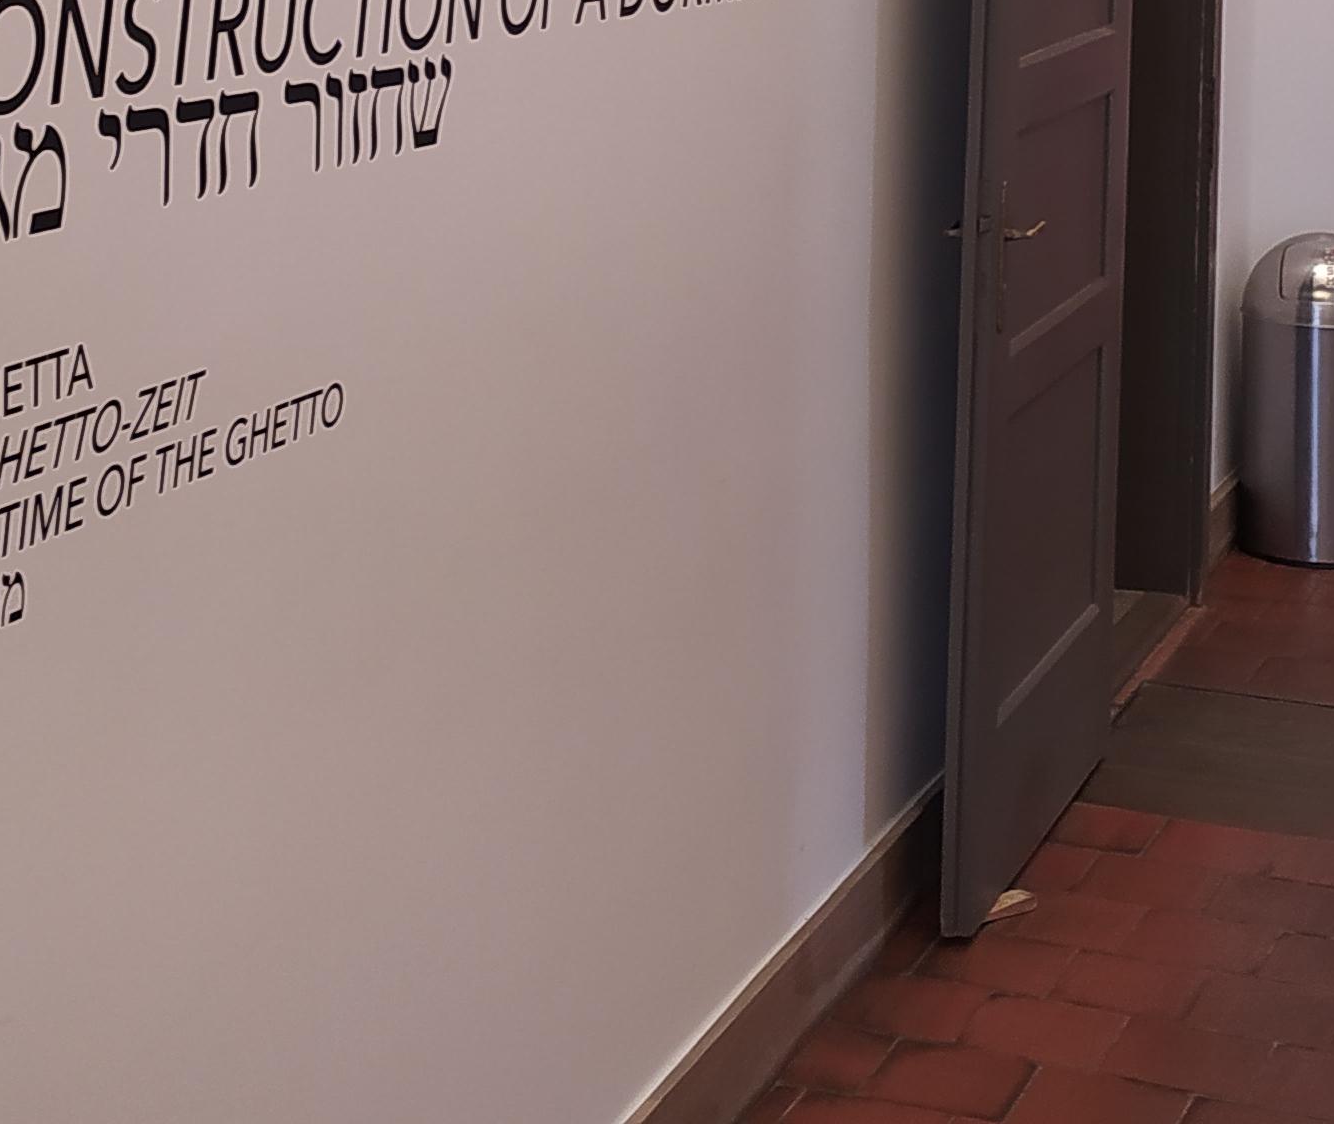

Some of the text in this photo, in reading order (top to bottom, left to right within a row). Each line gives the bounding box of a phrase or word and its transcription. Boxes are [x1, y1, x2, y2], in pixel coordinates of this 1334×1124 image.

[98, 90, 260, 206] חדרי
[284, 54, 452, 172] שחזור
[96, 453, 148, 517] OF
[155, 427, 218, 494] THE
[225, 382, 344, 466] GHETTO
